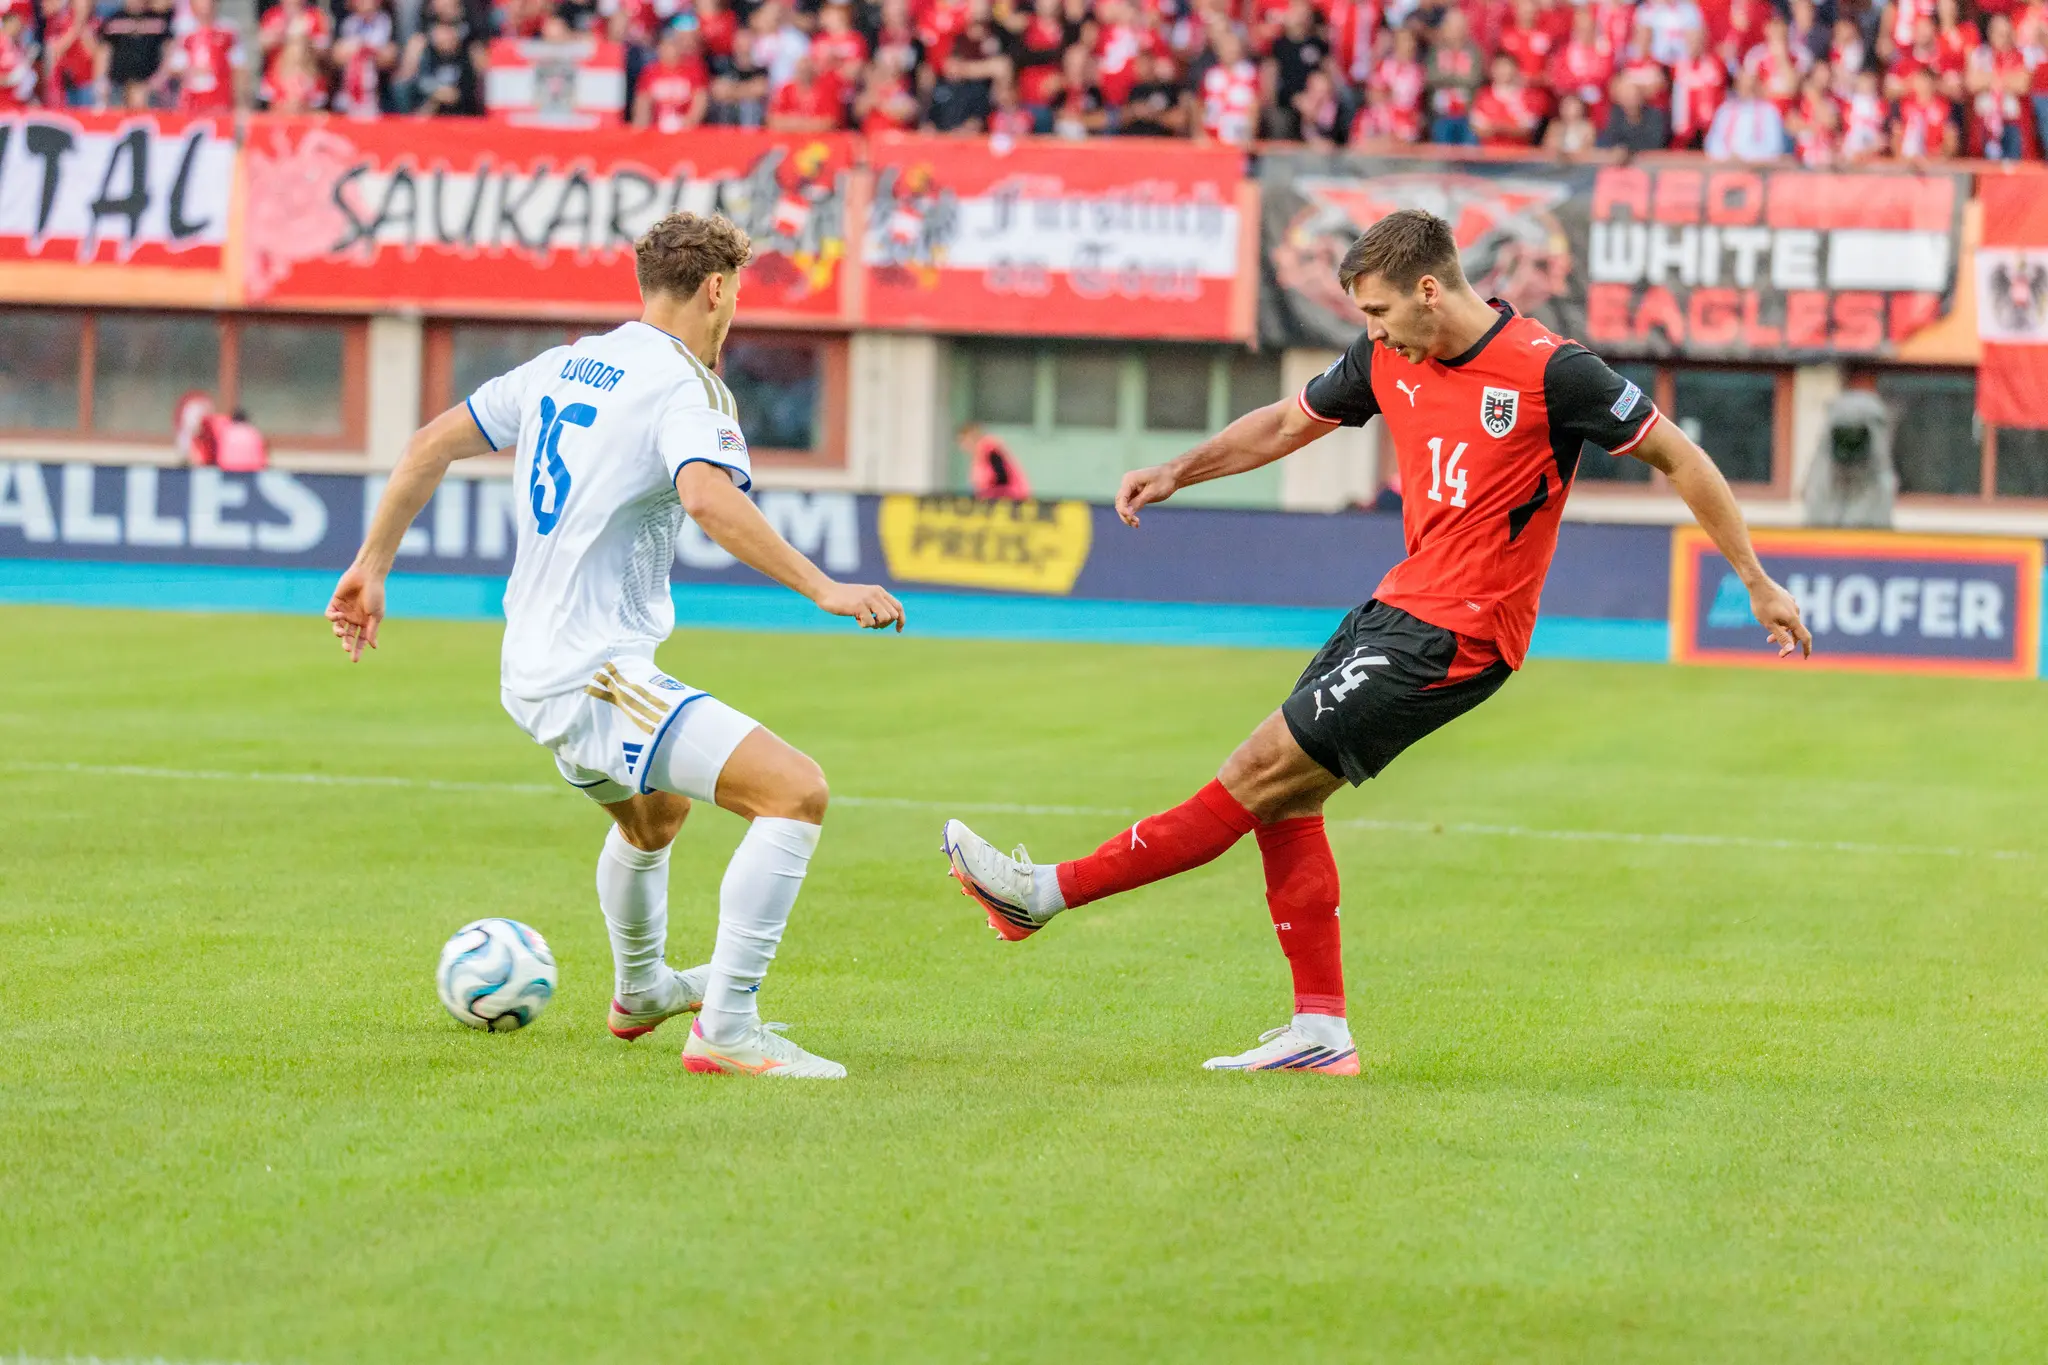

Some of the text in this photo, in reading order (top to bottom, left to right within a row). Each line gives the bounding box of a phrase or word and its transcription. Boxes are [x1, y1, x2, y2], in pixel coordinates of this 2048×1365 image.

[1592, 167, 1763, 226] RED
[1588, 222, 1820, 291] WHITE
[1585, 282, 1885, 352] EAGLES
[530, 395, 597, 536] 15
[1427, 437, 1469, 509] 14
[0, 463, 328, 553] ALLES
[1787, 574, 2004, 638] HOFER
